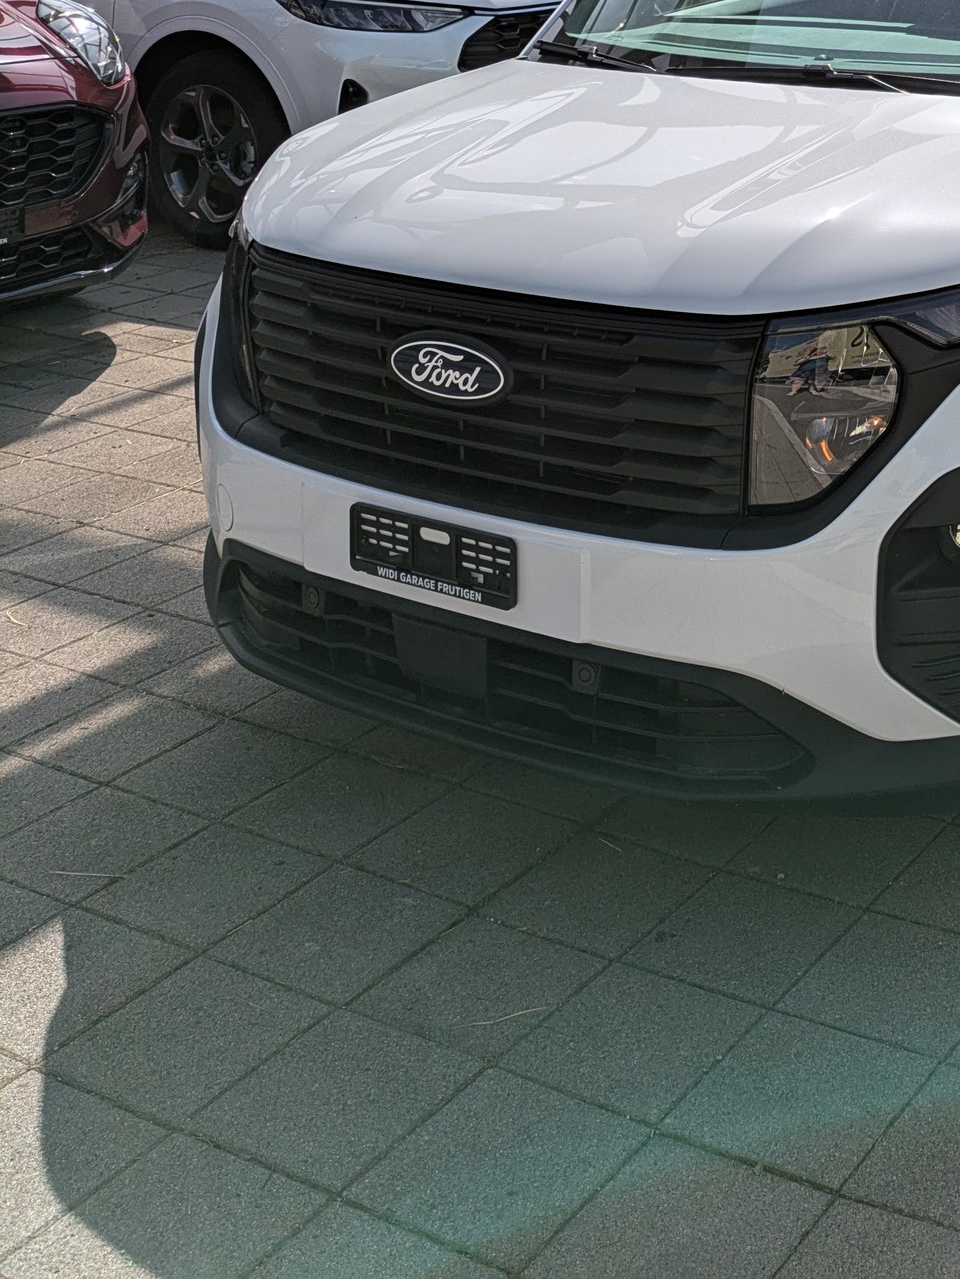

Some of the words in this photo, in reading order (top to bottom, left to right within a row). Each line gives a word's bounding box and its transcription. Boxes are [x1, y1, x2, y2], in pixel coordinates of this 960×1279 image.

[411, 347, 482, 392] Ford
[376, 565, 399, 580] WIDI
[399, 572, 436, 591] GARAGE
[437, 582, 482, 602] FRUTIGEN
